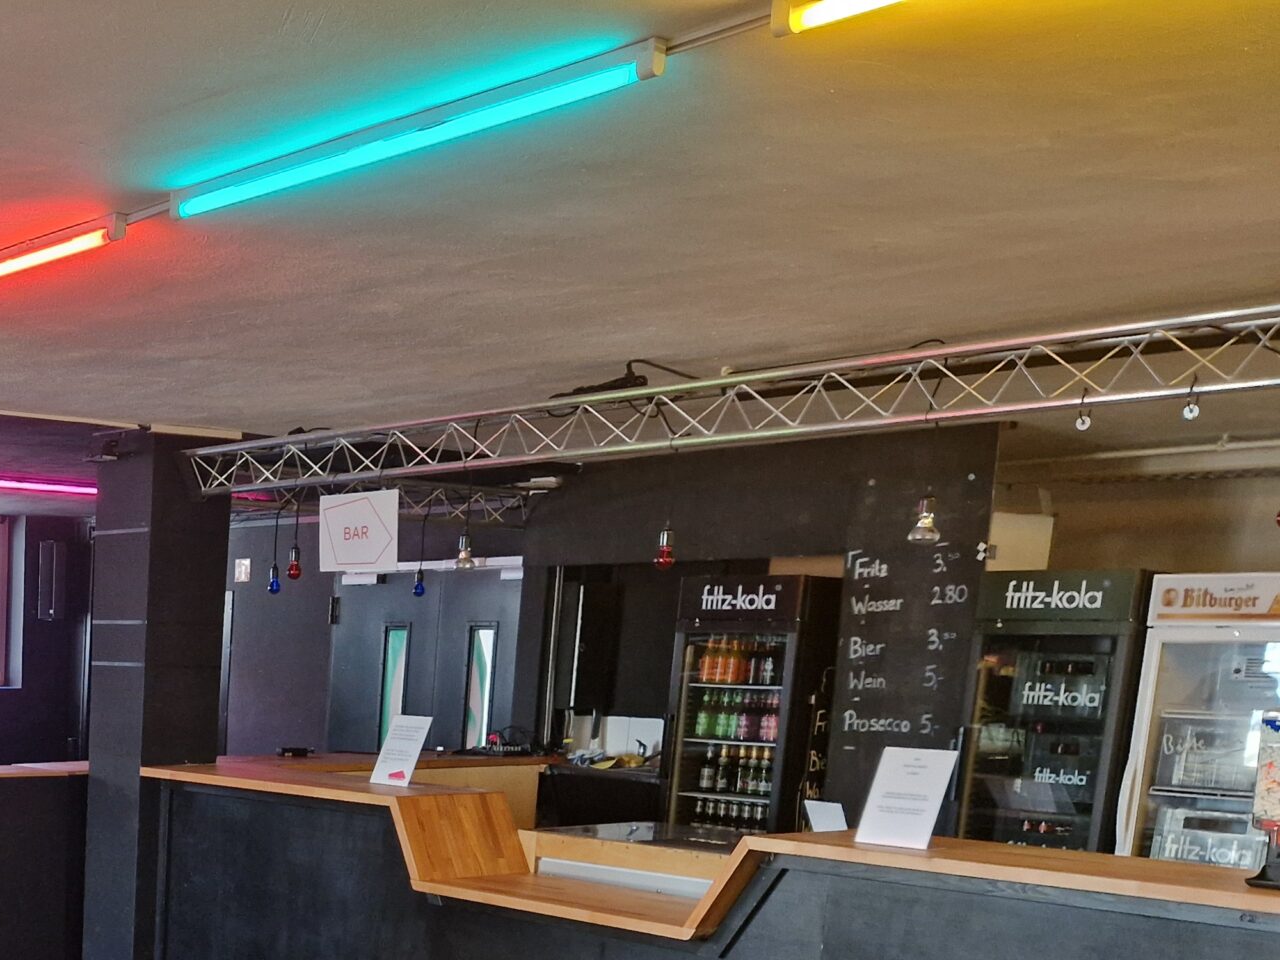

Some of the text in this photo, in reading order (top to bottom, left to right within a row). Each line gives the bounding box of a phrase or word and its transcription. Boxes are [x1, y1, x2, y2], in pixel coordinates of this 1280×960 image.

[343, 525, 369, 541] BAR
[853, 557, 889, 580] Fritz
[701, 584, 777, 610] fritz-kola
[851, 594, 904, 615] Wasser
[1005, 579, 1103, 609] fritz-kola
[1181, 587, 1260, 611] Bitburger
[848, 636, 887, 660] Bier
[848, 670, 887, 690] Wein
[1022, 681, 1101, 707] fritz-kola
[843, 709, 912, 732] Prosecco
[1033, 767, 1087, 785] fritz-kola
[1165, 833, 1253, 866] fritz-kola
